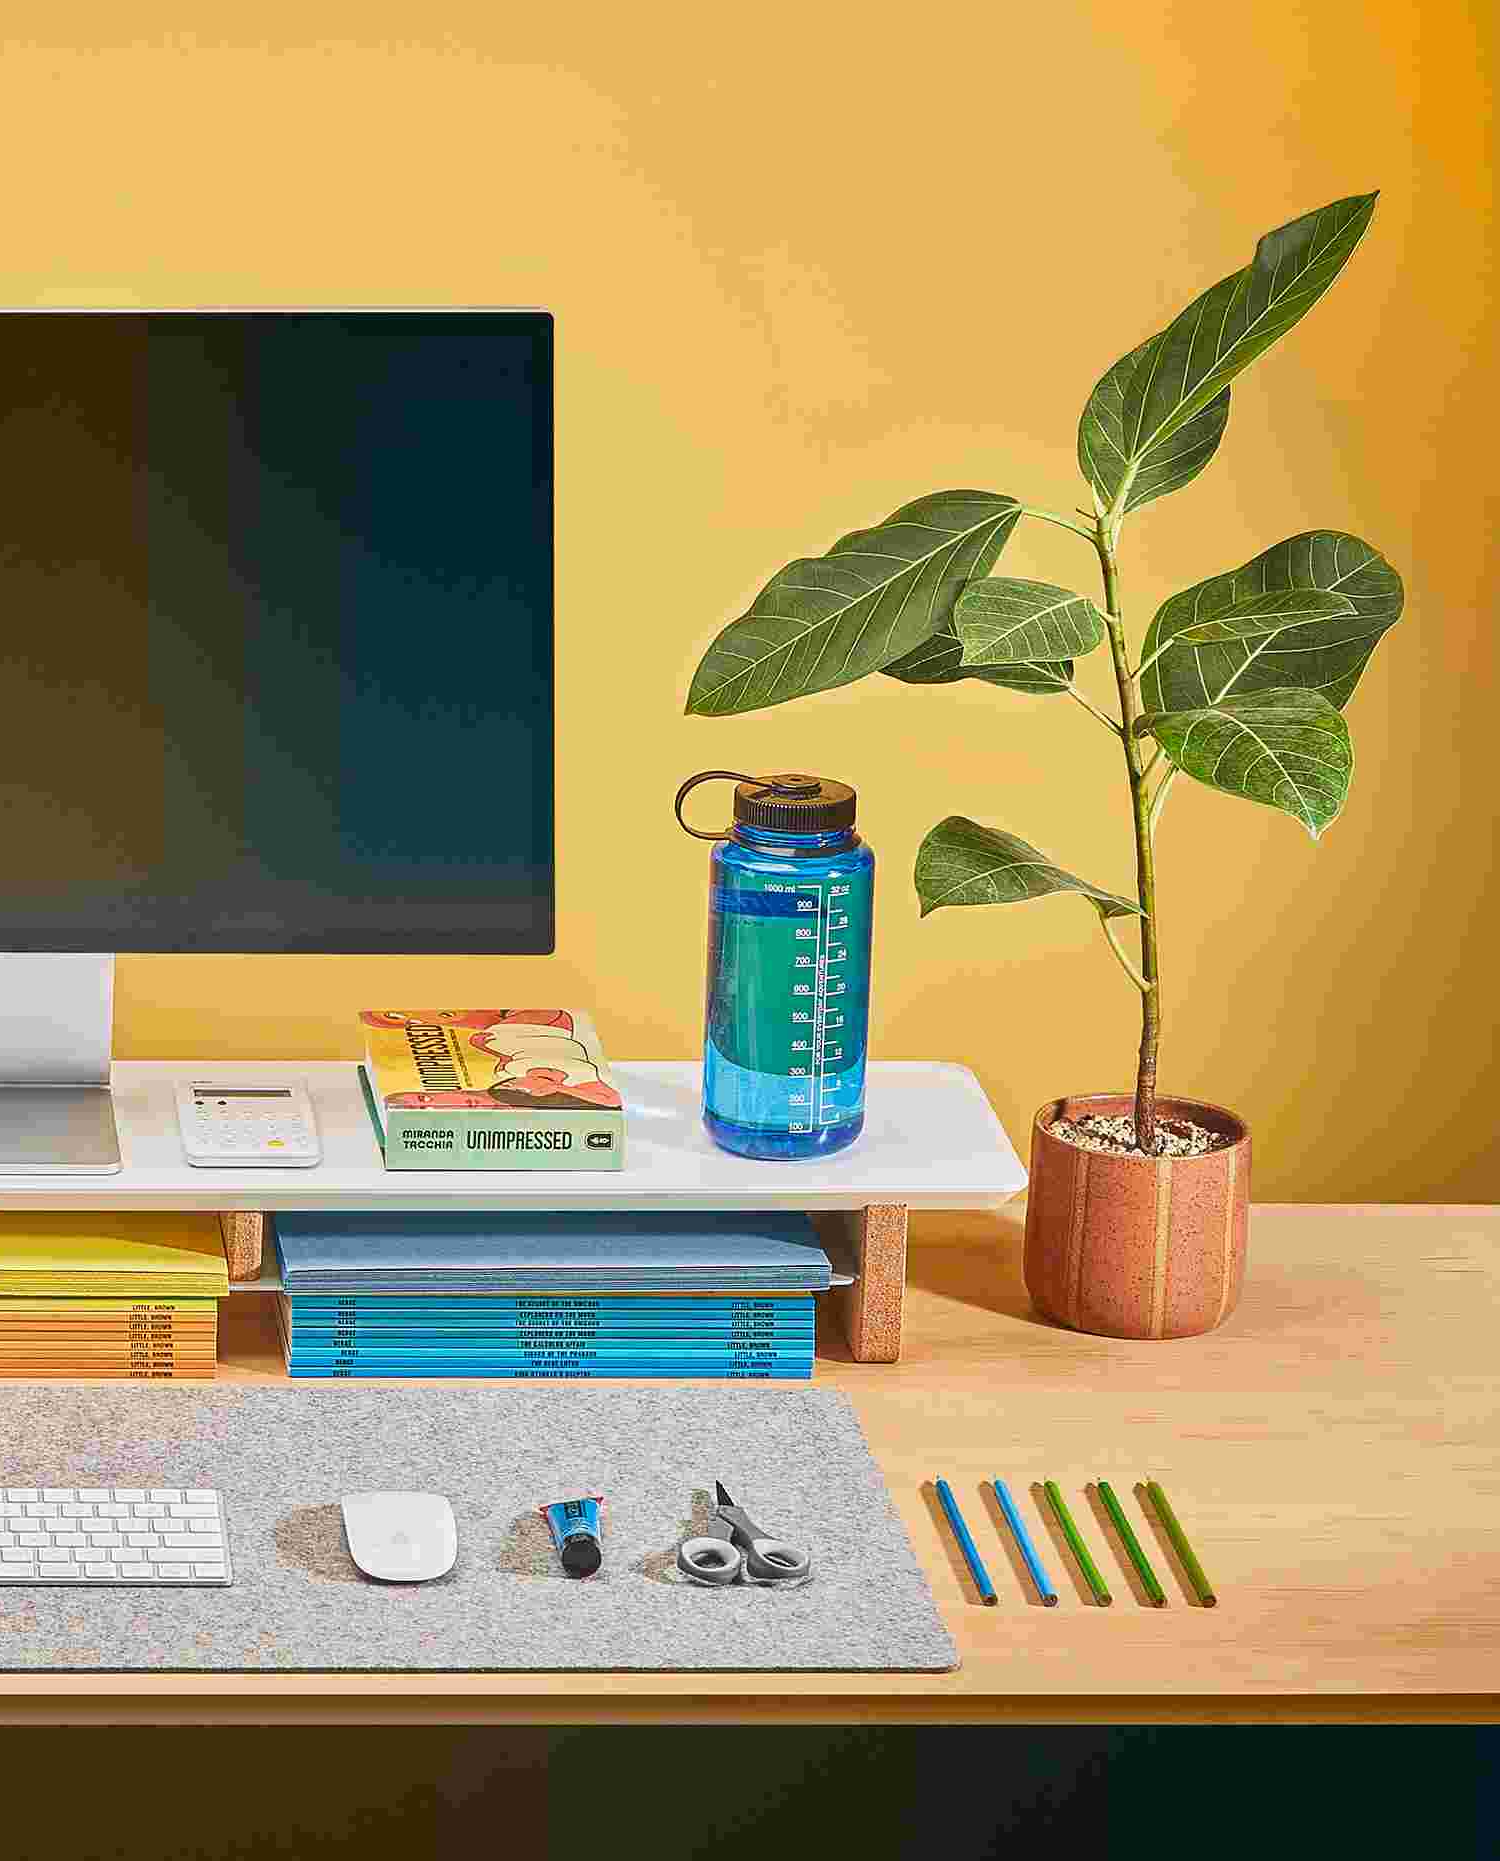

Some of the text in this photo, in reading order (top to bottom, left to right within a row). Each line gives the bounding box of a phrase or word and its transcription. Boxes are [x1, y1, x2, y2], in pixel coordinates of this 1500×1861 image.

[764, 884, 783, 893] 1000
[796, 900, 813, 908] 900
[795, 956, 811, 965] 700
[791, 1040, 807, 1048] 400
[404, 1022, 463, 1092] UNIMPRESSED
[402, 1129, 454, 1139] MIRANDA
[403, 1140, 453, 1149] TACCHIA
[467, 1131, 573, 1150] UNIMPRESSED
